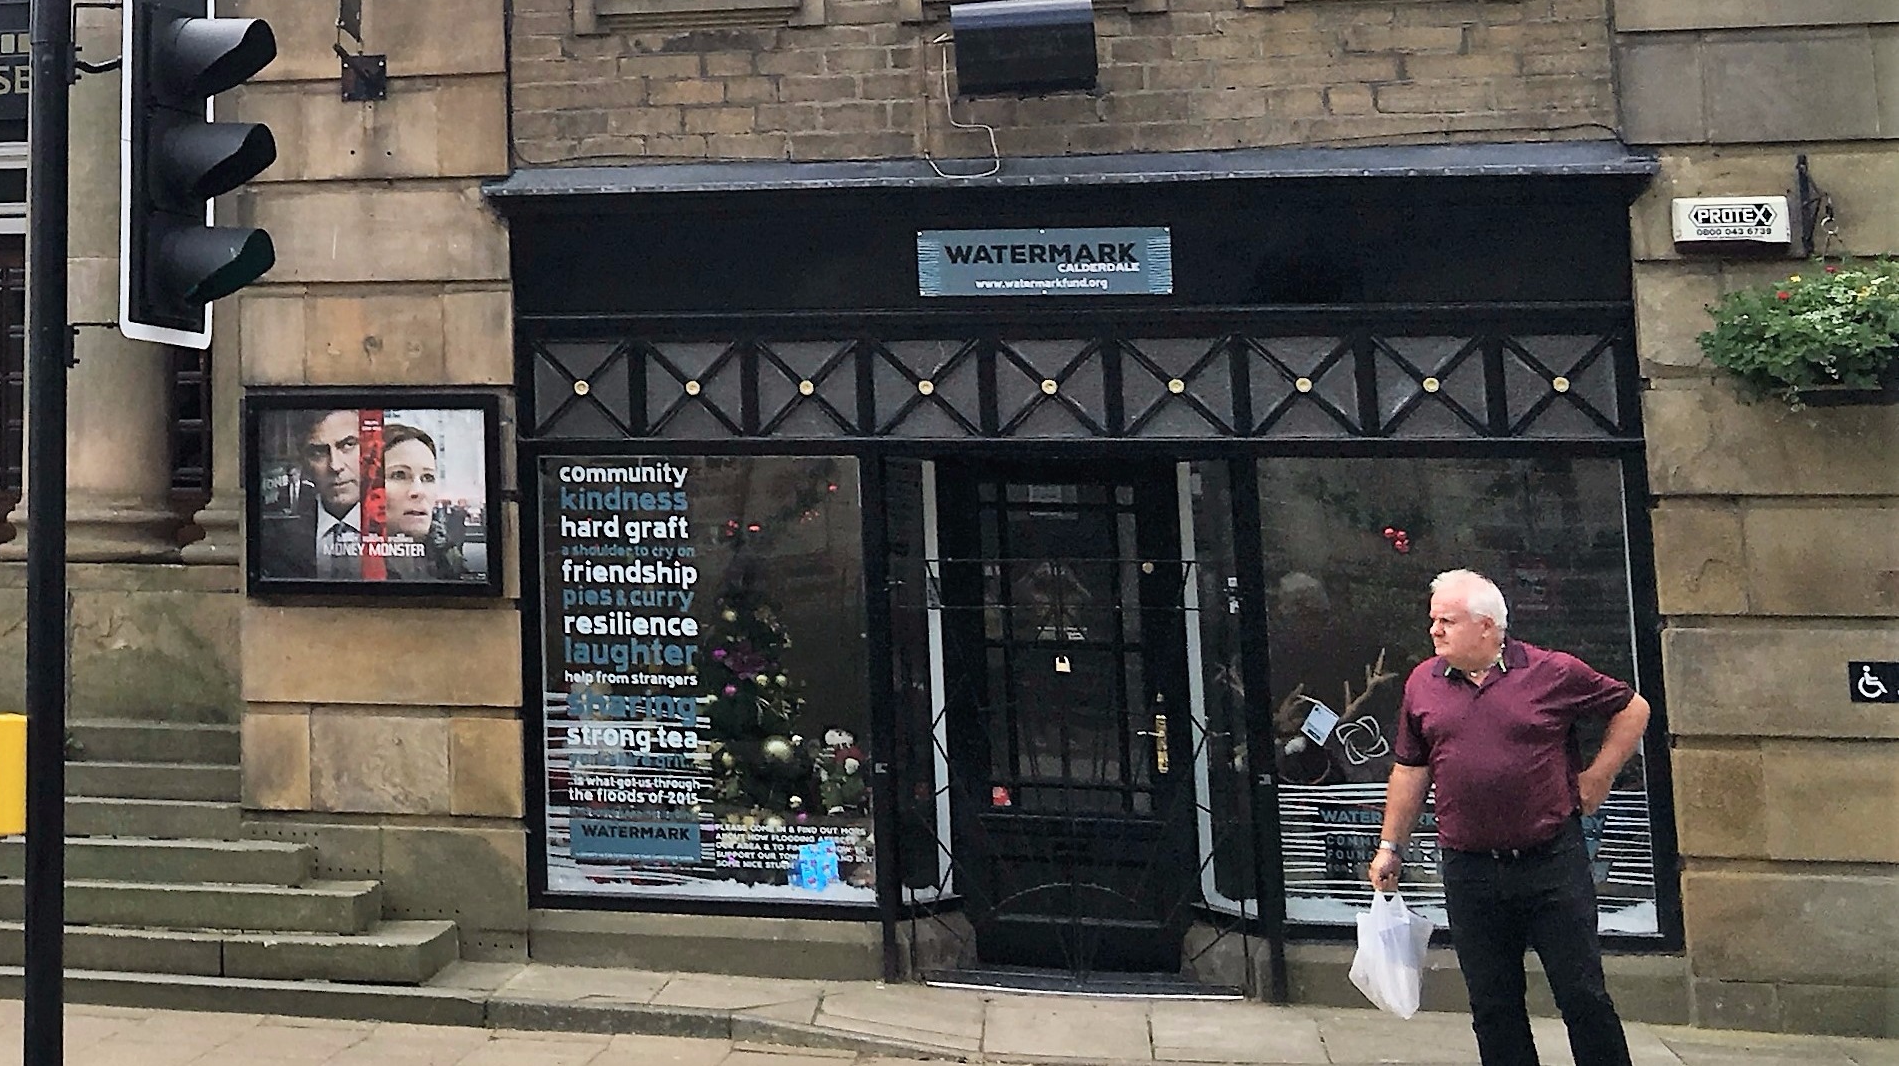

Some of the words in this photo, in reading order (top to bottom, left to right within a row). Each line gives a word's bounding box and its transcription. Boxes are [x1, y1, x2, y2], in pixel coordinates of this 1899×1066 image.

[1698, 205, 1768, 226] PROTEX
[1697, 228, 1722, 236] 0800
[944, 243, 1138, 264] WATERMARK
[1057, 262, 1140, 273] CALDERDALE
[975, 278, 1108, 290] www.watermarkfund.org
[559, 462, 688, 488] community
[560, 486, 689, 511] kindness
[561, 514, 619, 538] hard
[625, 515, 689, 544] graft
[323, 542, 365, 556] MONEY
[369, 542, 425, 557] MONSTER
[561, 545, 569, 556] a
[572, 544, 633, 557] shoulder
[634, 545, 648, 556] to
[652, 547, 674, 560] cry
[677, 546, 695, 557] on
[562, 559, 698, 589] friendship
[563, 585, 613, 610] pies
[616, 589, 627, 607] &
[630, 589, 695, 613] curry
[564, 611, 699, 636] resilience
[564, 636, 699, 673] laughter
[565, 670, 594, 685] help
[595, 671, 629, 685] from
[631, 672, 698, 688] strangers
[566, 686, 697, 727] sharing
[567, 725, 651, 753] strong
[657, 725, 698, 749] tea
[586, 775, 616, 788] what
[617, 777, 637, 790] got
[638, 779, 652, 789] us
[653, 777, 701, 791] through
[569, 787, 594, 802] the
[597, 787, 644, 803] floods
[648, 791, 665, 804] of
[667, 792, 699, 805] 2015
[581, 824, 691, 841] WATERMARK
[819, 826, 838, 835] OUT
[757, 852, 777, 860] OUR
[772, 843, 784, 851] TO
